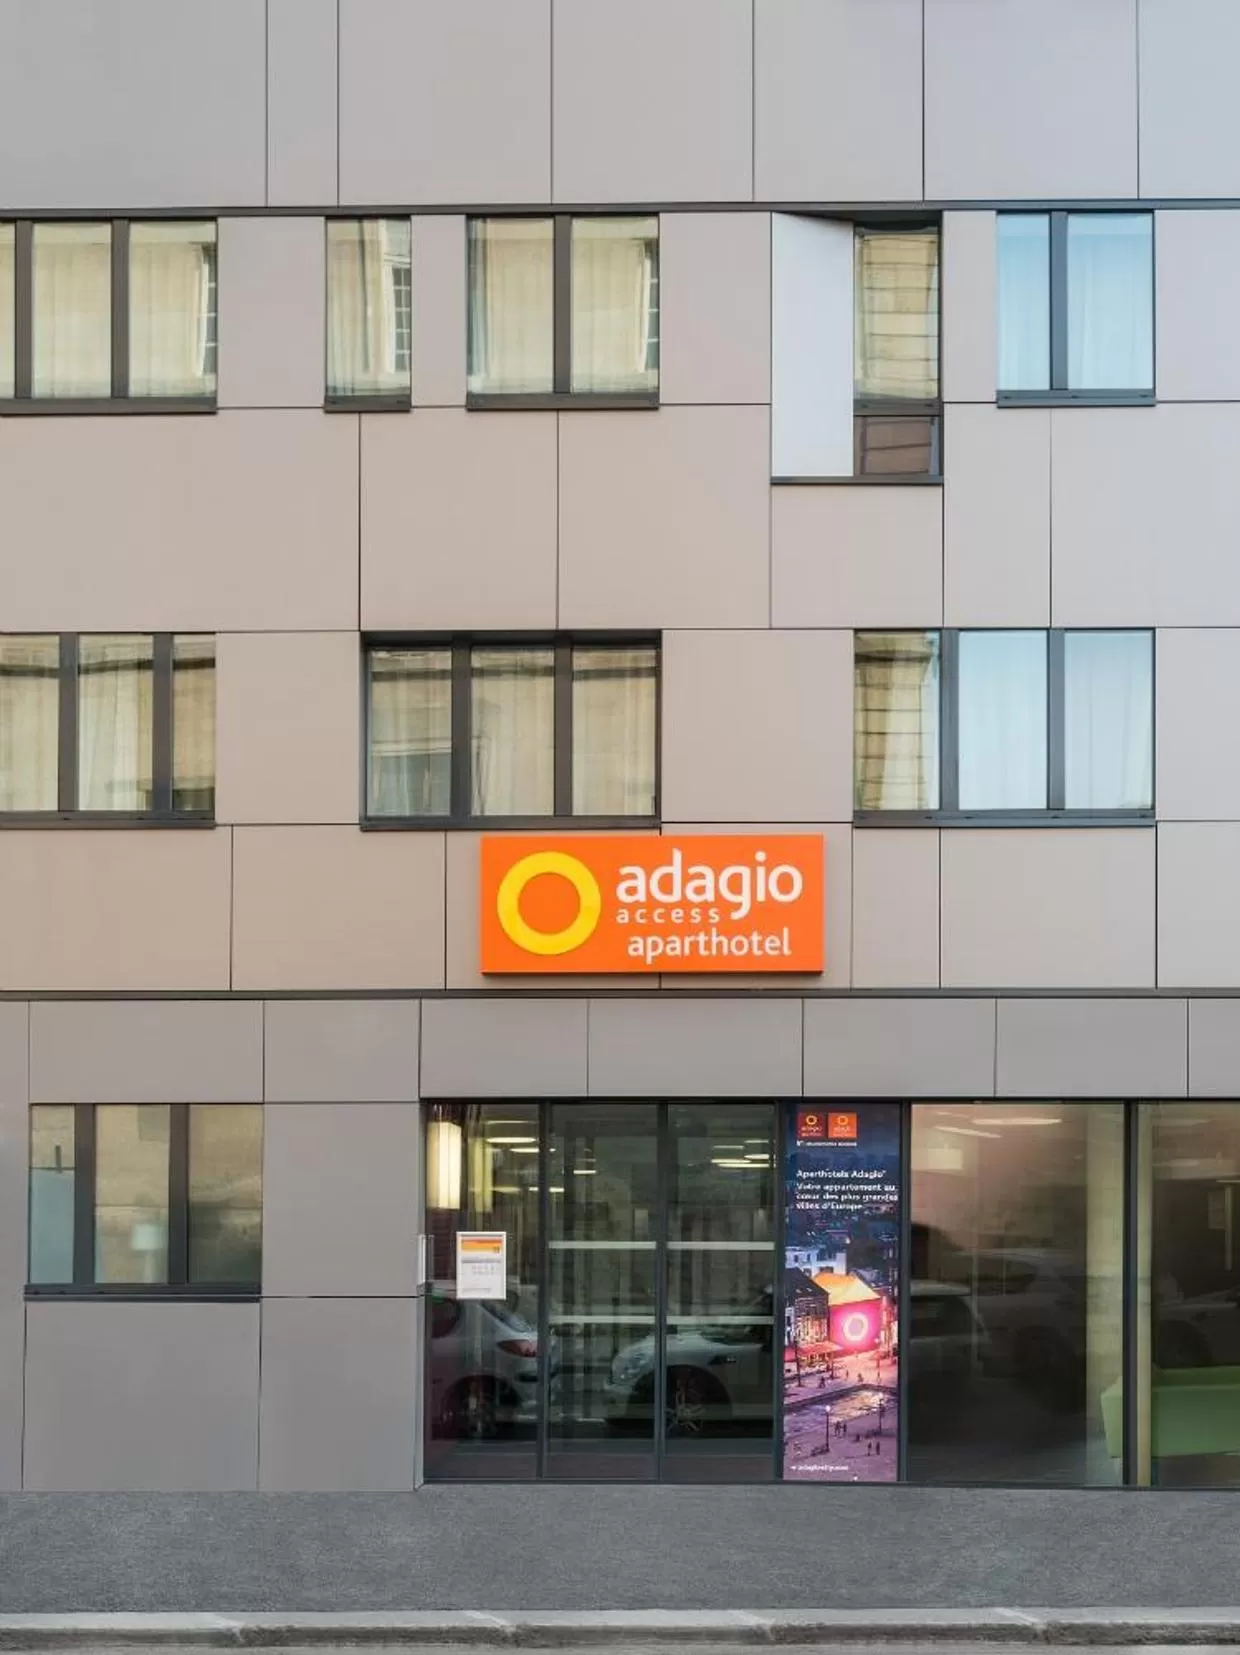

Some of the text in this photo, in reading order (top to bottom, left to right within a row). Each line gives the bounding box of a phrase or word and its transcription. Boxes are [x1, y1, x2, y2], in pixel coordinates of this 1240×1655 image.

[616, 848, 804, 920] adagio
[616, 907, 720, 924] access
[627, 927, 792, 965] aparthotel
